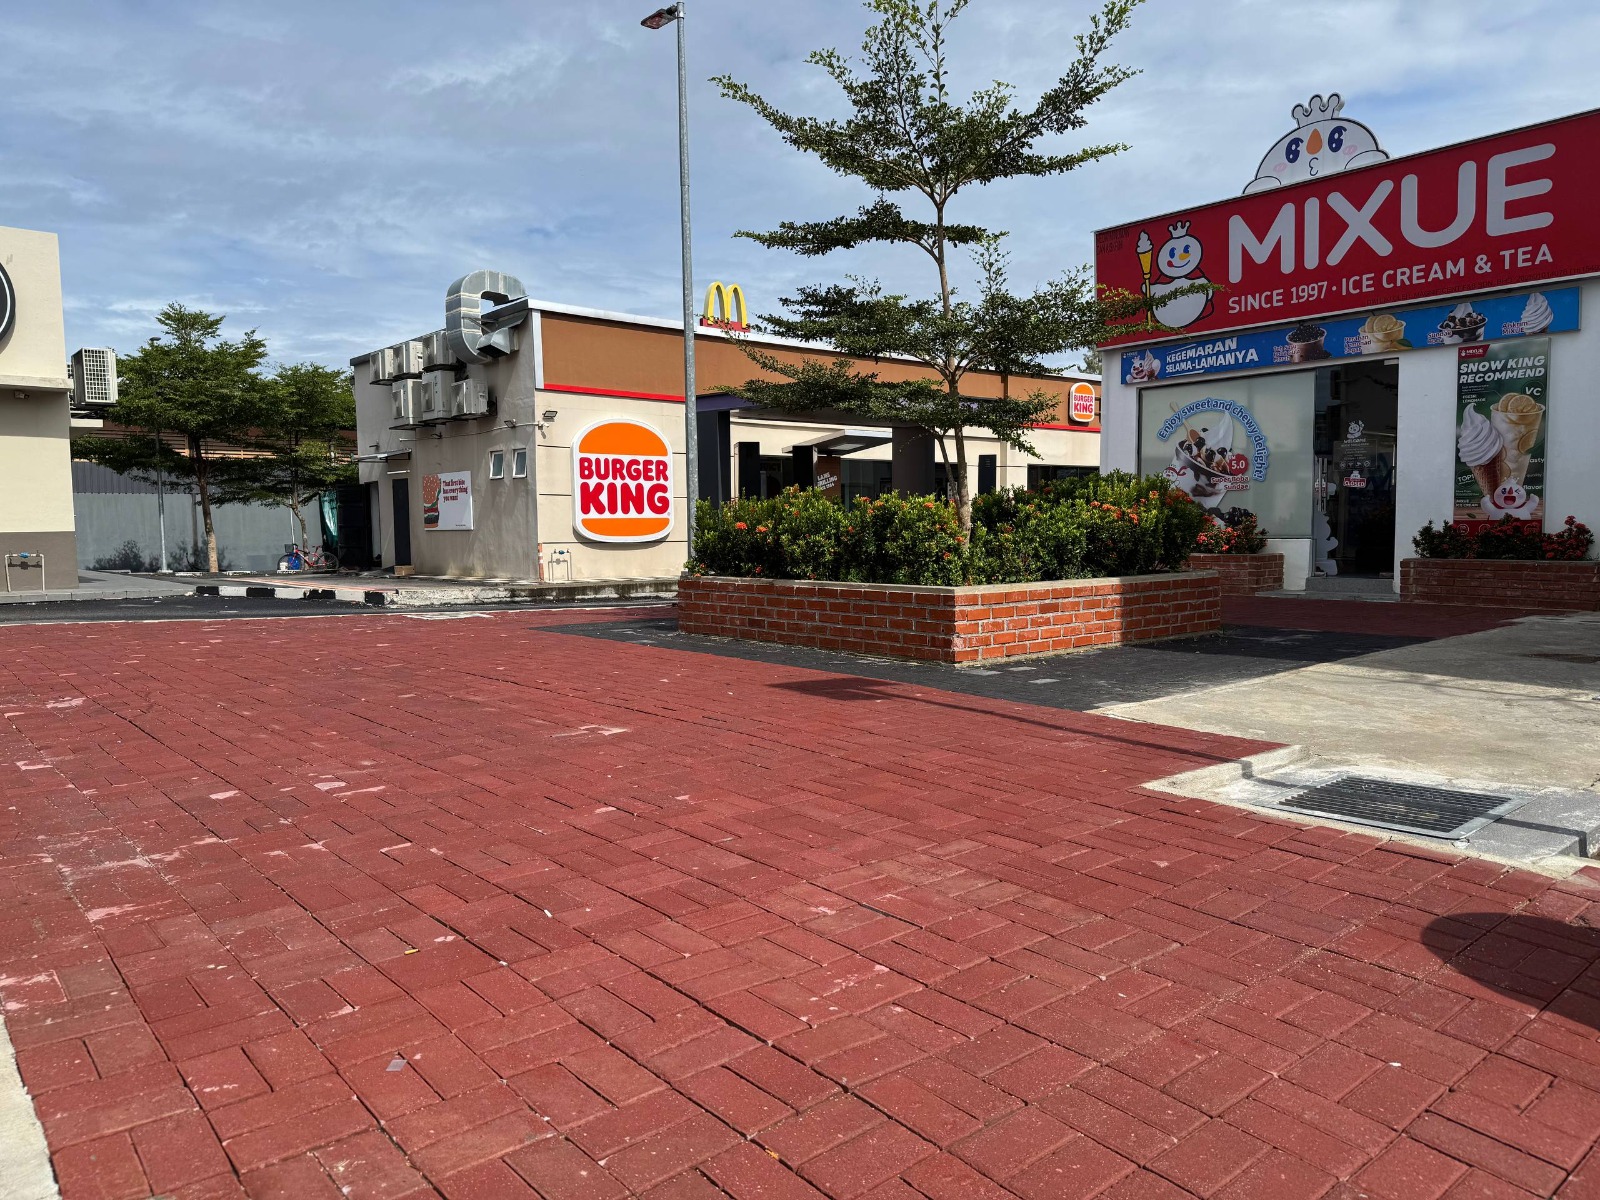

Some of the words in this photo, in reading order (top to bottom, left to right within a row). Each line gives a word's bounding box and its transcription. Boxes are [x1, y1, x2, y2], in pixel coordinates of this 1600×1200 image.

[1229, 143, 1556, 283] MIXUE
[1229, 289, 1284, 314] SINCE
[1290, 281, 1328, 304] 1997
[1341, 273, 1375, 296] ICE
[1382, 257, 1465, 288] CREAM
[1474, 254, 1492, 274] &
[1500, 244, 1554, 270] TEA
[1502, 321, 1528, 330] Aiskrim
[1502, 327, 1525, 336] MIXUE
[1166, 337, 1238, 363] KEGEMARAN
[1165, 348, 1259, 373] SELAMA-LAMANYA
[1459, 359, 1506, 374] SNOW
[1507, 355, 1546, 369] KING
[1459, 367, 1545, 384] RECOMMEND
[1074, 394, 1094, 403] BURGER
[1525, 386, 1542, 396] VC
[1073, 402, 1094, 413] KING
[1158, 412, 1182, 439] Enjoy
[1181, 398, 1212, 417] sweet
[1212, 399, 1233, 411] and
[1231, 405, 1259, 434] chewy
[1253, 434, 1268, 479] delight!
[578, 457, 669, 482] BURGER
[1231, 460, 1245, 470] 5.0
[1457, 473, 1475, 482] TOP!
[580, 482, 670, 515] KING
